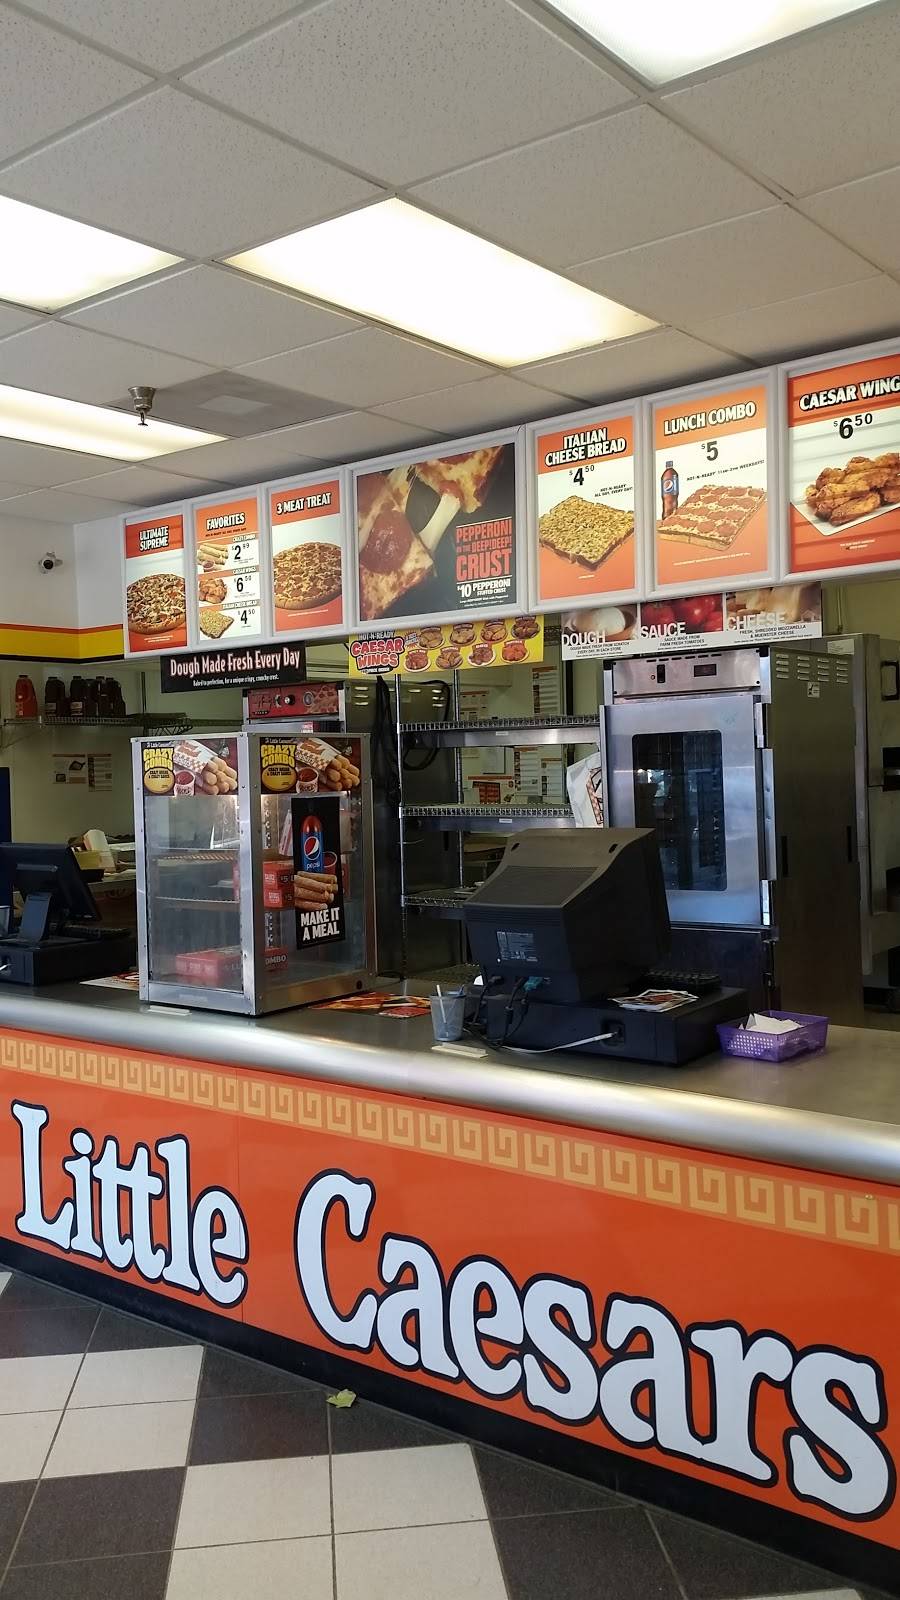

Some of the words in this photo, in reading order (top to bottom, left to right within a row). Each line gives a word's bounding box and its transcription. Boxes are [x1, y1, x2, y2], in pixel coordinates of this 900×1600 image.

[799, 385, 859, 411] CAESAR
[664, 412, 706, 436] LUNCH
[707, 401, 757, 426] COMBO
[563, 427, 608, 449] ITALIAN
[545, 446, 586, 467] CHEESE
[587, 437, 627, 459] BREAD
[701, 441, 719, 461] $5
[276, 502, 283, 515] 3
[283, 497, 305, 514] MEAT
[306, 492, 332, 510] TREAT
[206, 512, 246, 531] FAVORITES
[456, 519, 512, 543] PEPPERONI
[139, 525, 169, 541] ULTIMATE
[139, 536, 169, 552] SUPREME
[456, 548, 512, 582] CRUST
[457, 583, 472, 598] $10
[472, 578, 511, 591] PEPPERONI
[640, 621, 687, 639] SAUCE
[728, 611, 787, 631] CHEESE
[350, 637, 405, 658] CAESAR
[561, 629, 606, 646] DOUGH
[170, 656, 200, 678] Dough
[201, 654, 226, 673] Made
[227, 651, 253, 672] Fresh
[254, 650, 282, 671] Every
[282, 647, 300, 669] Day
[356, 653, 399, 670] WINGS
[143, 748, 174, 762] CRAZY
[261, 744, 297, 758] CRAZY
[262, 753, 296, 769] COMBO
[144, 756, 174, 772] COMBO
[306, 861, 320, 871] pepsi
[300, 909, 329, 927] MAKE
[330, 907, 340, 921] IT
[302, 927, 311, 942] A
[312, 921, 340, 940] MEAL
[11, 1099, 249, 1309] Little
[294, 1167, 896, 1522] Caesars
